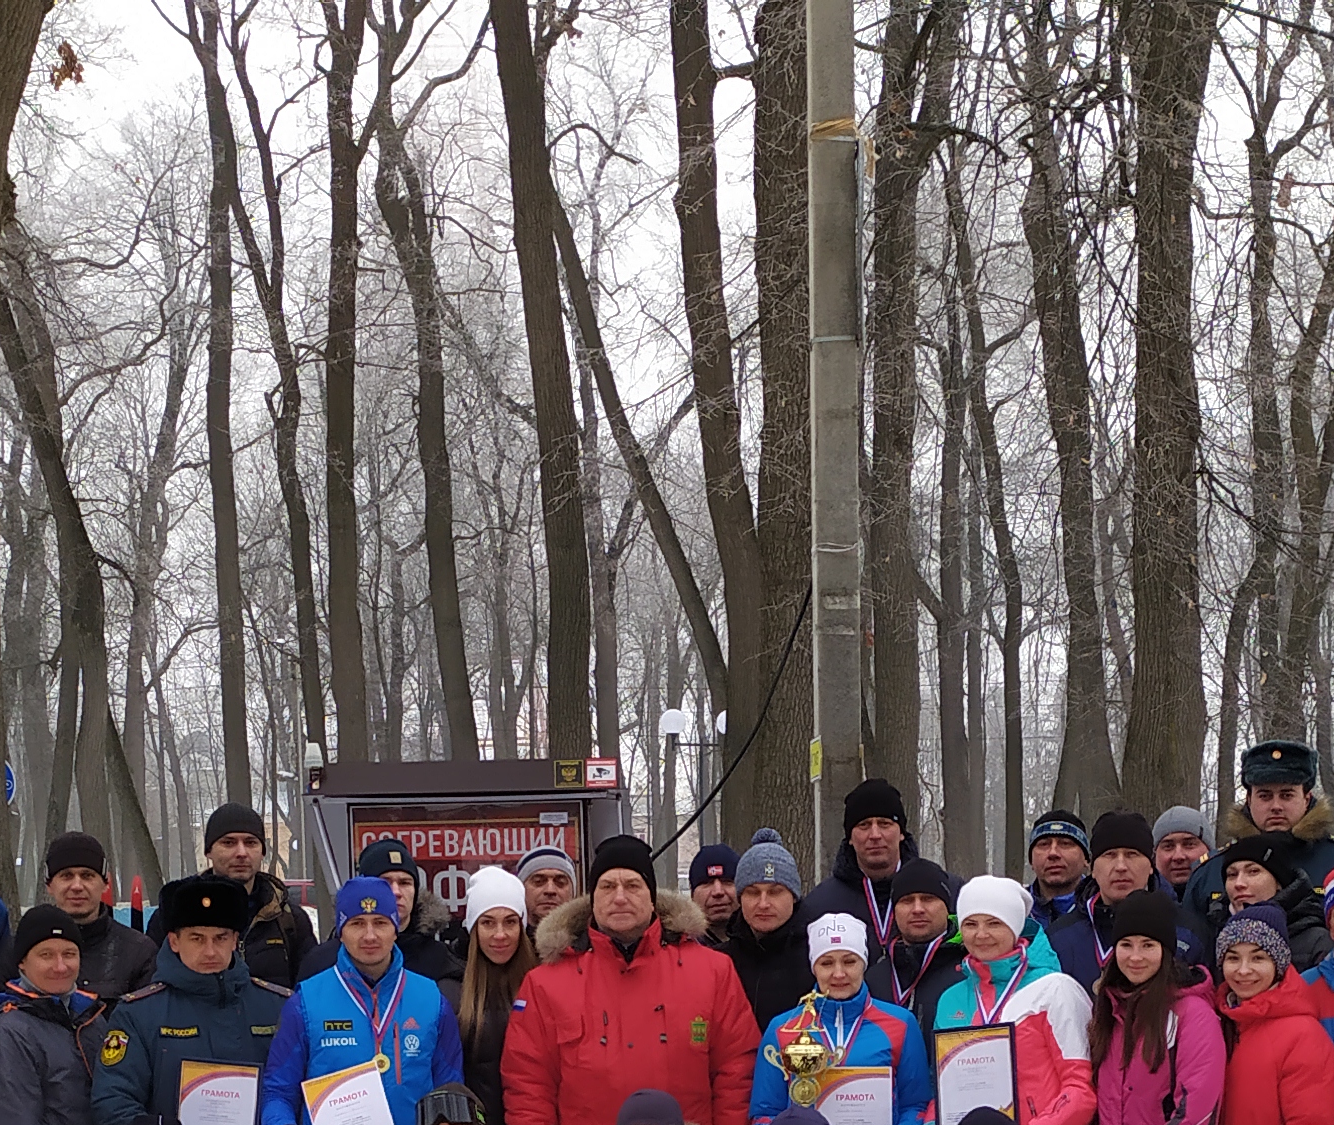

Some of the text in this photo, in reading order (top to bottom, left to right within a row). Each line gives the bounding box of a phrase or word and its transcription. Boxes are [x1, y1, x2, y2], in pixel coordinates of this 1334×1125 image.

[320, 1037, 358, 1047] LUKOIL
[957, 1056, 996, 1066] ГРАМОТА
[200, 1089, 241, 1099] ГРАМОТА
[329, 1089, 369, 1107] ГРАМОТА
[835, 1093, 875, 1101] ГРАМОТА
